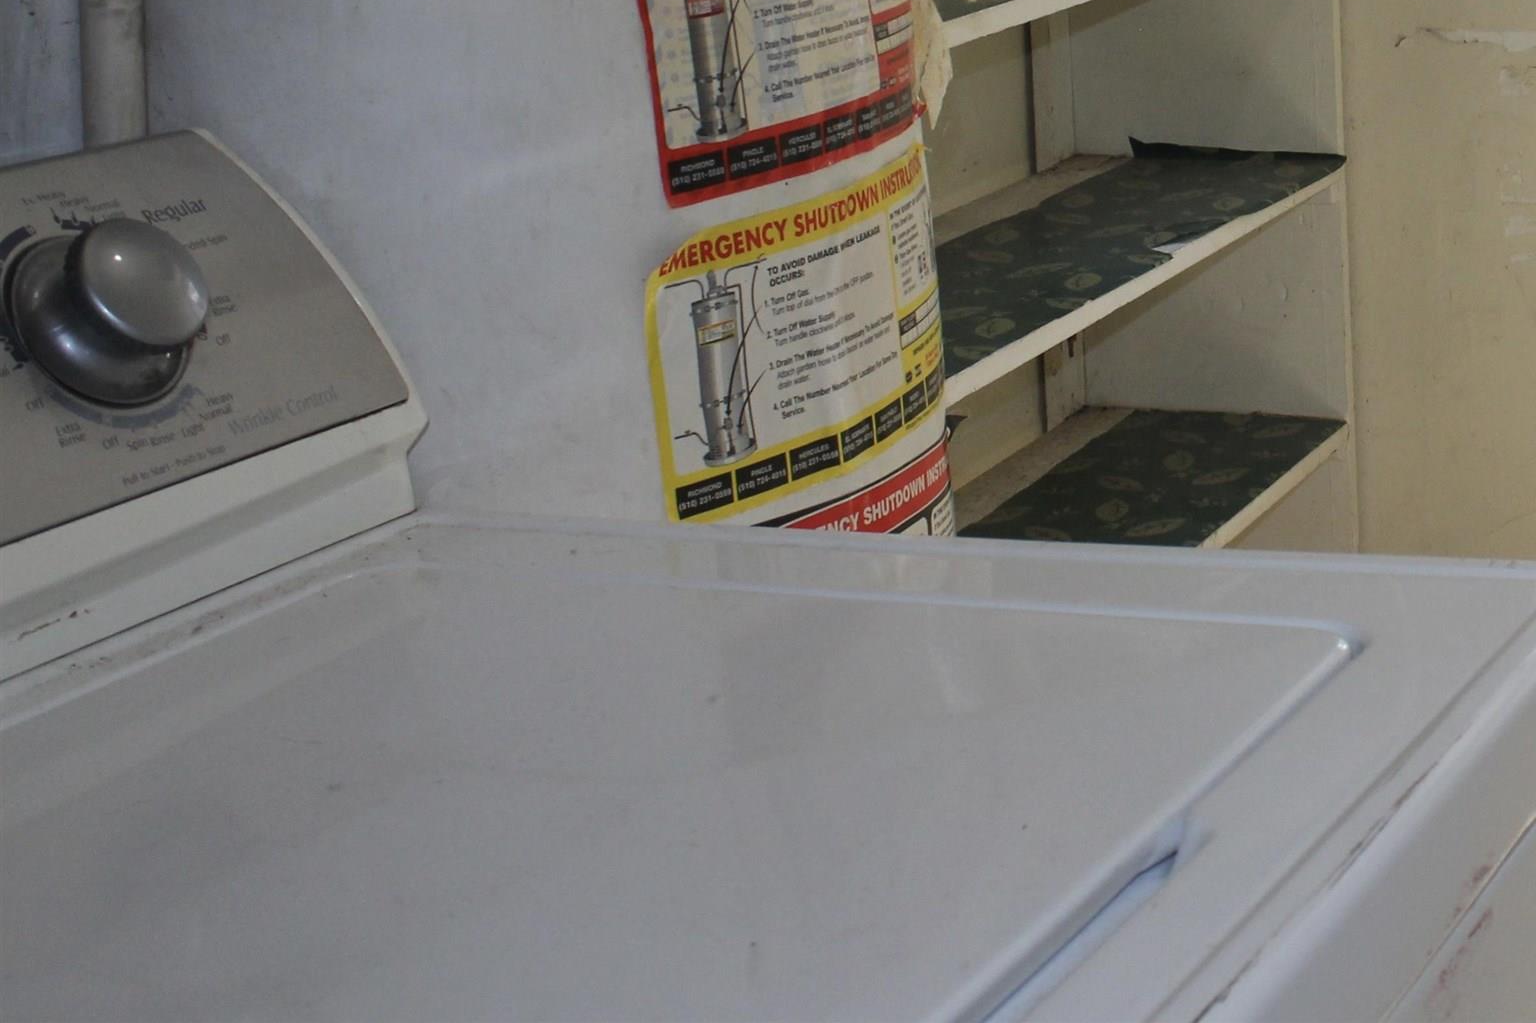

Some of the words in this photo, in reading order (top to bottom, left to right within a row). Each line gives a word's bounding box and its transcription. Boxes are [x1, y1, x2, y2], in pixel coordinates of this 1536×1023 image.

[140, 198, 208, 225] Regular
[659, 218, 788, 277] EMERGENCY
[793, 187, 880, 237] SHUTDOWN
[767, 266, 778, 276] TO
[781, 257, 806, 272] AVOID
[807, 246, 839, 263] DAMAGE
[856, 225, 881, 244] LEAKAGE
[770, 294, 785, 305] Turn
[786, 290, 796, 301] Off
[772, 305, 785, 316] Turn
[786, 302, 796, 313] top
[774, 326, 788, 337] Turn
[788, 321, 798, 332] Off
[775, 337, 788, 347] Turn
[776, 356, 793, 369] Drain
[794, 351, 805, 362] The
[806, 347, 825, 358] Water
[26, 398, 44, 411] Off
[780, 397, 792, 409] Call
[794, 392, 805, 403] The
[806, 386, 831, 400] Number
[227, 405, 283, 436] Wrinkle
[285, 385, 338, 417] Control
[55, 423, 81, 436] Extra
[181, 423, 205, 438] Light
[58, 433, 86, 448] Rinse
[102, 436, 120, 450] Off
[126, 436, 149, 451] Spin
[150, 431, 176, 447] Rinse
[122, 472, 139, 486] Pull
[140, 469, 150, 481] to
[687, 481, 723, 498] RICHMOND
[863, 475, 926, 524] SHUTDOWN
